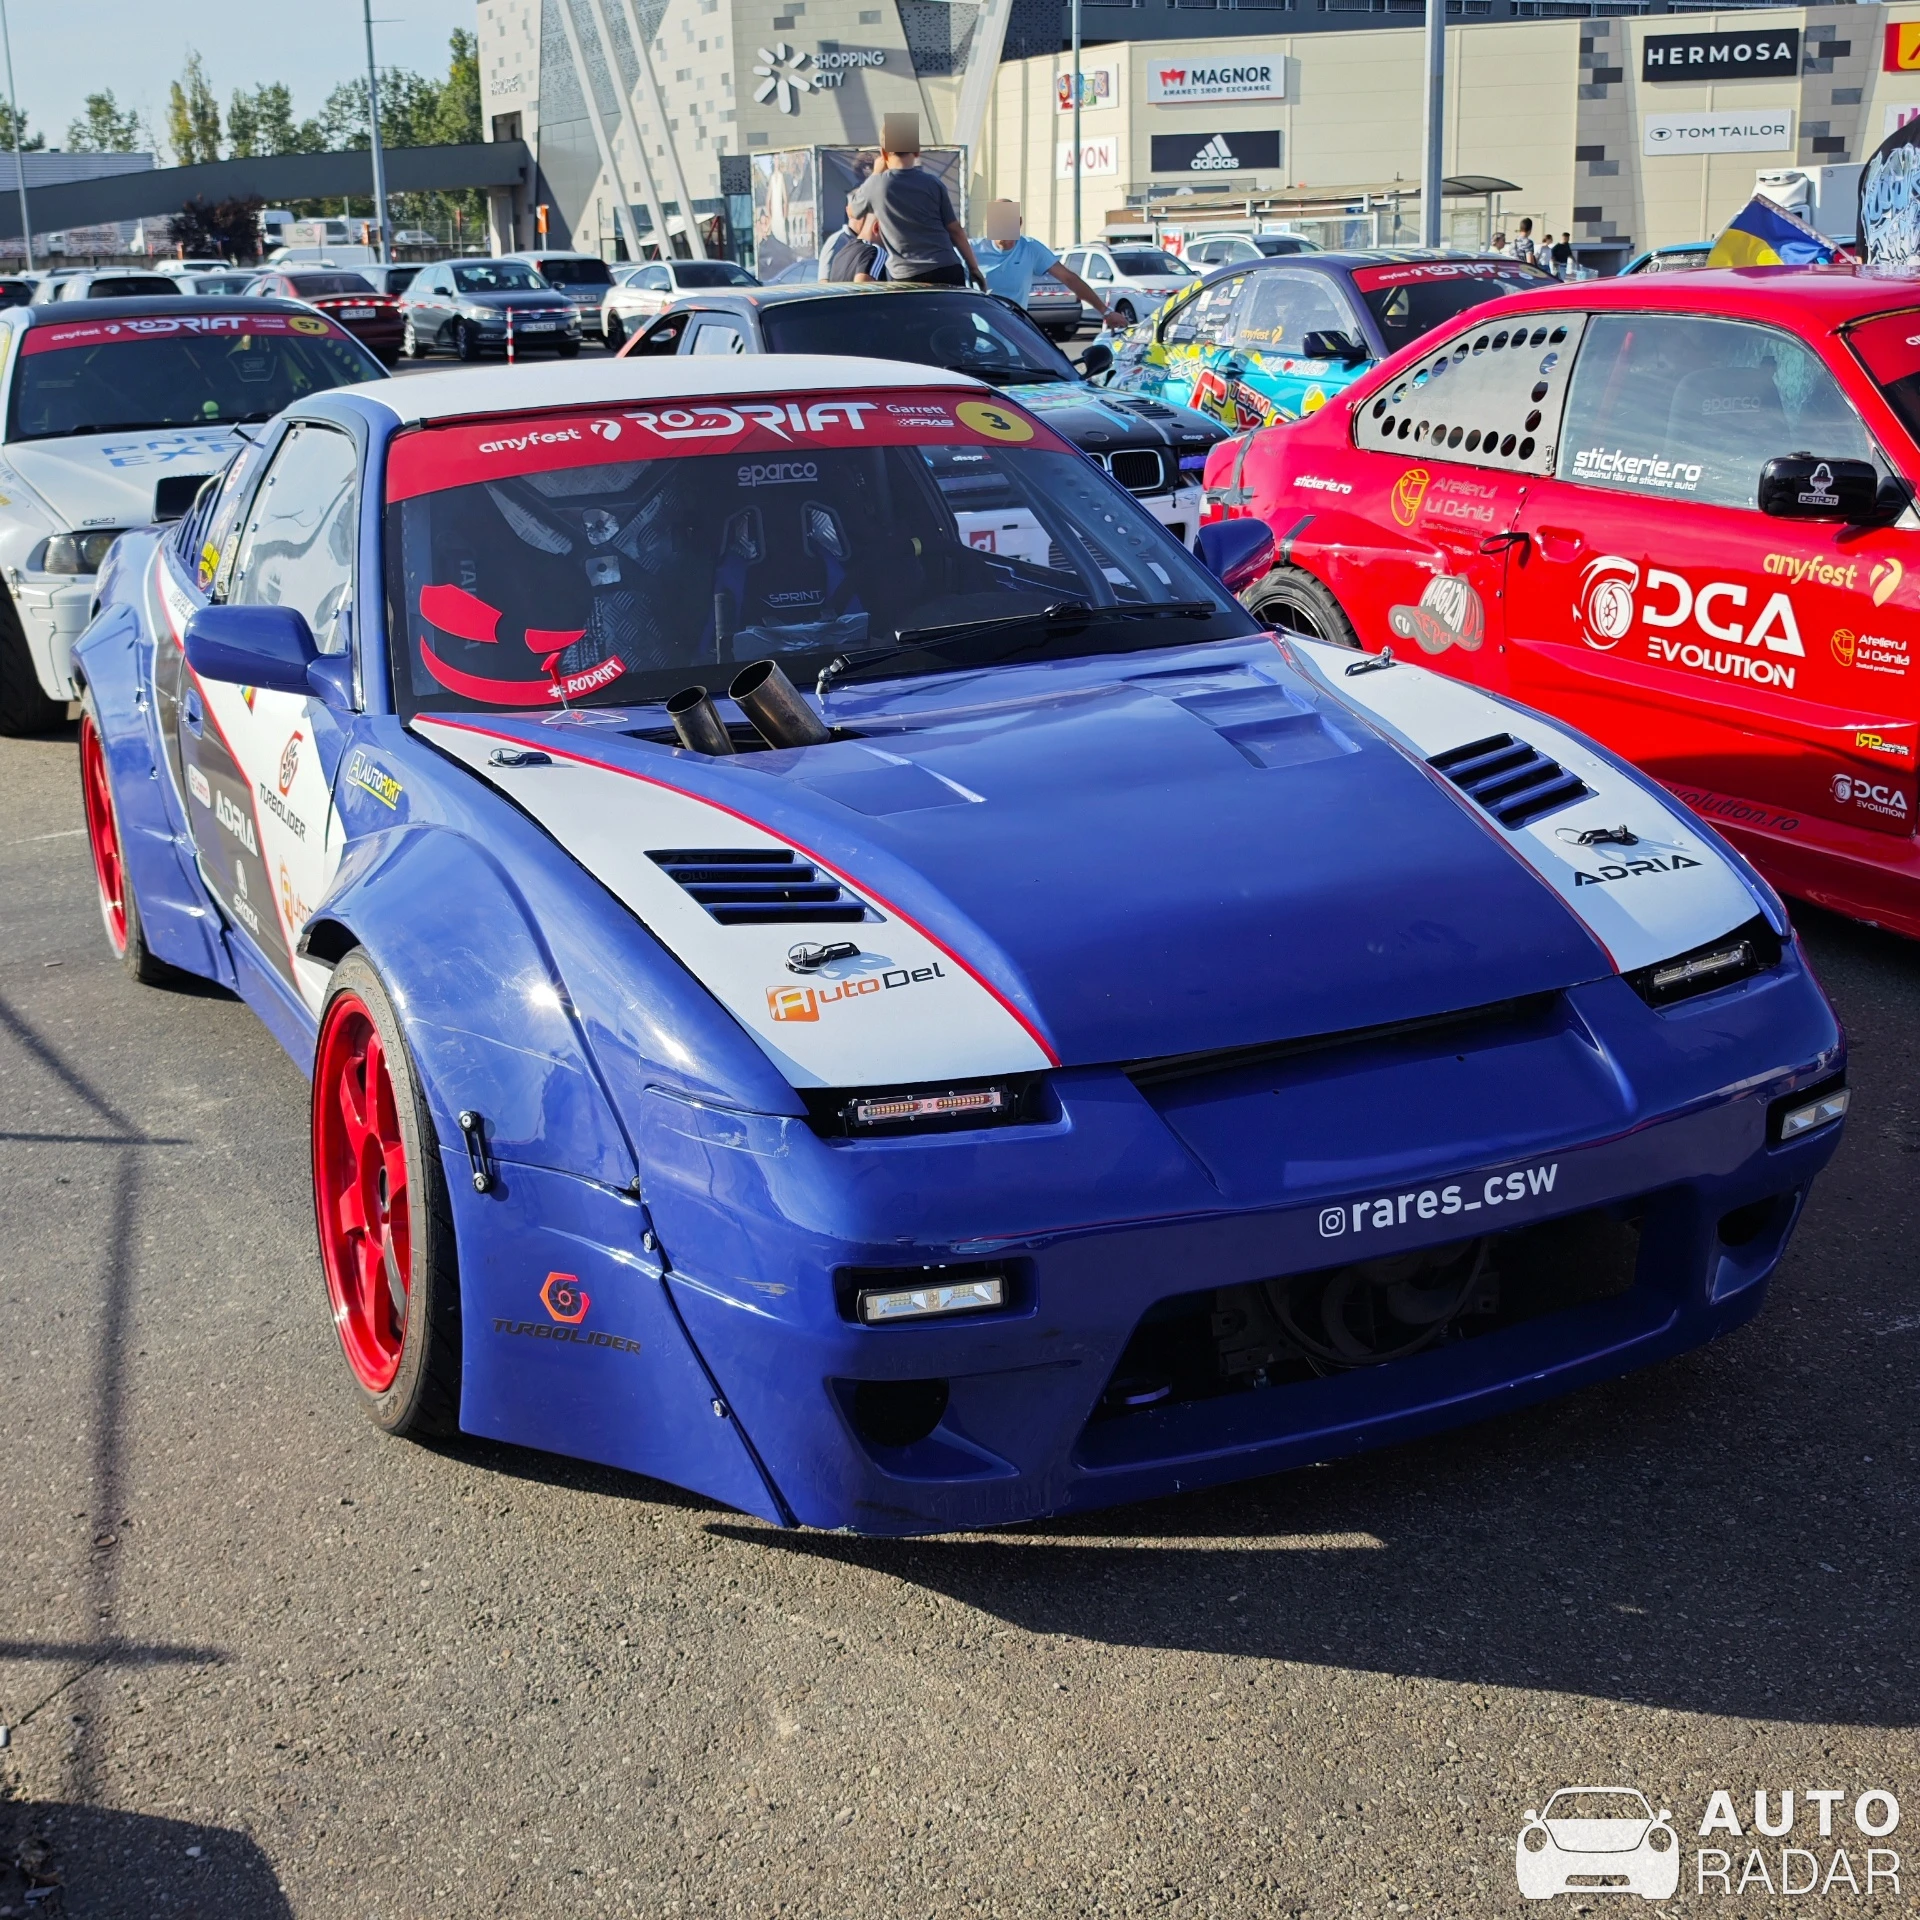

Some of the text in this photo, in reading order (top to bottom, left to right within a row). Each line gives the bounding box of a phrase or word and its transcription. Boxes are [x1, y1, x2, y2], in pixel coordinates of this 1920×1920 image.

[811, 51, 885, 69] SHOPPING
[1647, 42, 1792, 66] HERMOSA
[812, 72, 844, 88] CITY
[1191, 66, 1271, 86] MAGNOR
[1163, 88, 1198, 96] AMANET
[1226, 85, 1272, 93] EXCHANGE
[1676, 127, 1715, 139] TOM
[1718, 125, 1785, 137] TAILOR
[1190, 157, 1240, 170] adidas
[51, 328, 102, 342] anyfest
[298, 321, 319, 331] 57
[479, 428, 582, 454] anyfest
[886, 404, 947, 415] Garrett
[980, 412, 1012, 431] 3
[737, 462, 818, 487] sparco
[1574, 447, 1703, 483] stickerie.ro
[1294, 475, 1352, 495] stickerie.ro
[1571, 466, 1611, 480] Magazinul
[1627, 475, 1638, 483] de
[1639, 476, 1674, 489] stickere
[1674, 481, 1698, 492] auto!
[1763, 553, 1858, 590] anyfest
[769, 590, 822, 604] SPRINT
[1648, 636, 1796, 690] EVOLUTION
[215, 789, 259, 858] ADRIA
[1574, 854, 1704, 887] ADRIA
[766, 962, 946, 1023] AutoDel
[1352, 1163, 1559, 1233] rares_csw
[492, 1317, 642, 1356] TURBOLIDER
